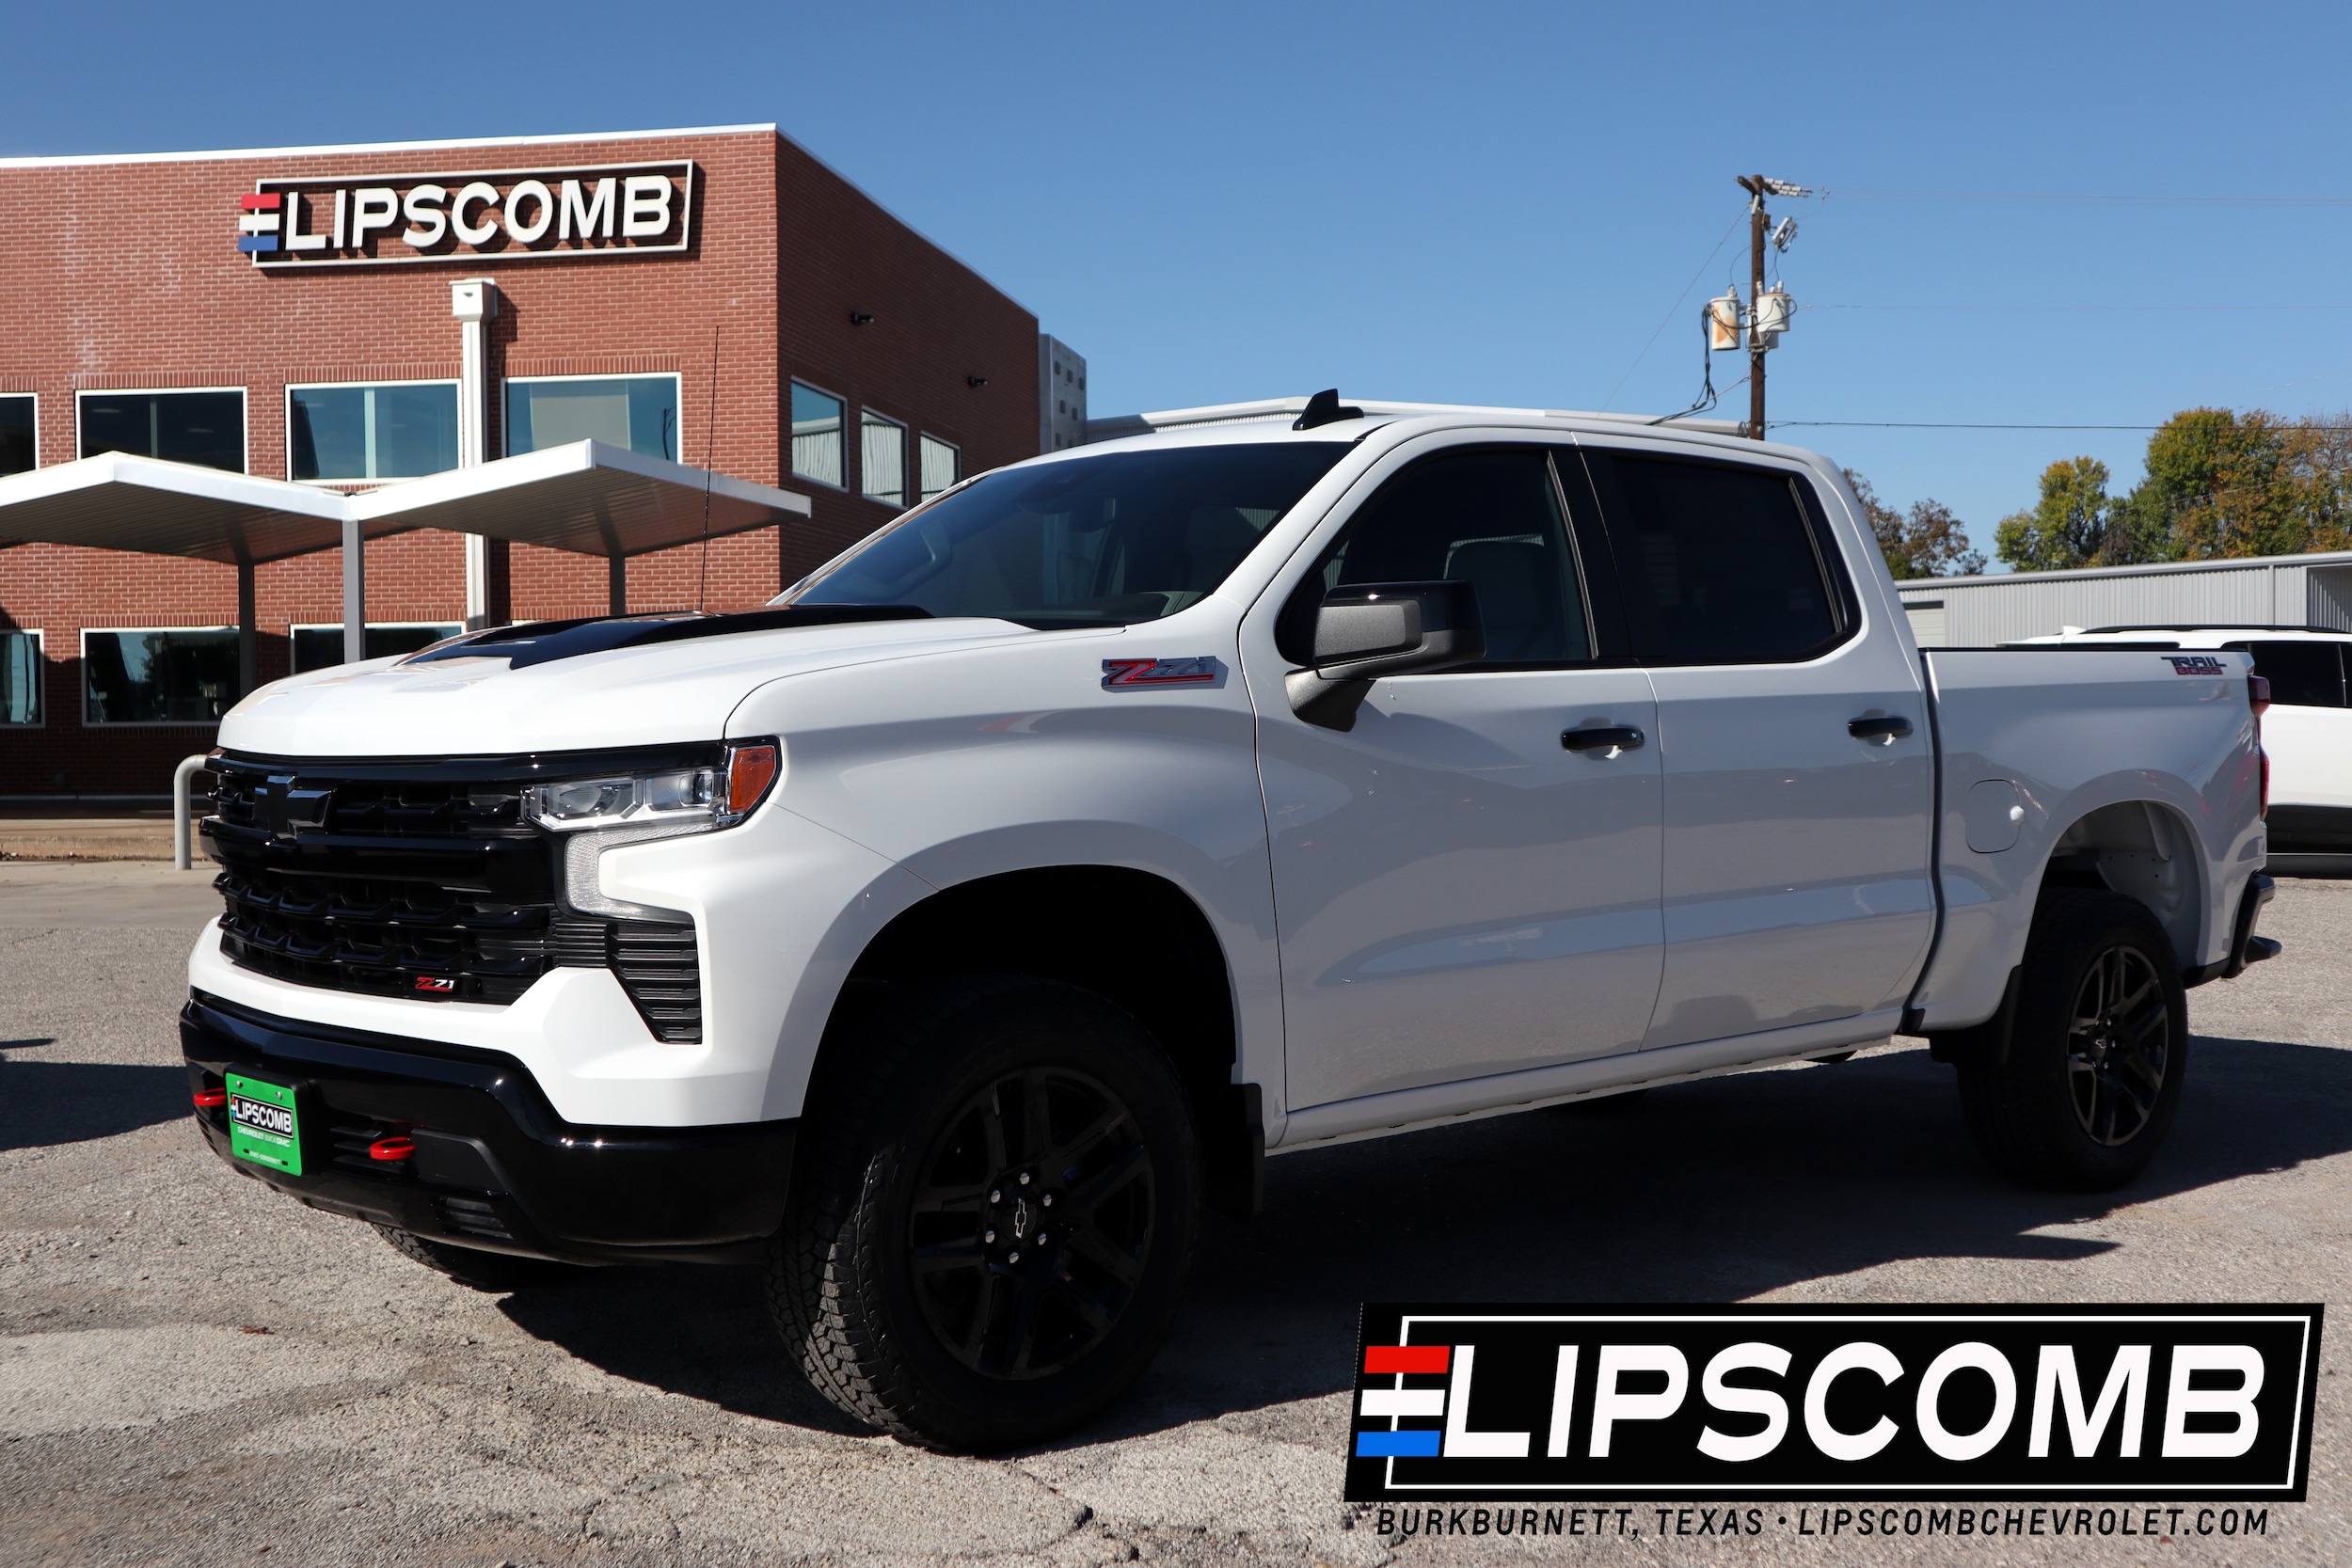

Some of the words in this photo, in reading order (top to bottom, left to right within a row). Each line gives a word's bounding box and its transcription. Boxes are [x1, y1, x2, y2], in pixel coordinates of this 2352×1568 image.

[285, 175, 672, 250] LIPSCOMB
[2160, 657, 2228, 667] TRAIL
[1102, 656, 1216, 689] Z71
[2175, 666, 2223, 675] BOSS
[415, 976, 455, 991] Z71
[235, 1100, 292, 1132] LIPSCOMB
[237, 1126, 264, 1140] CHEVROLET
